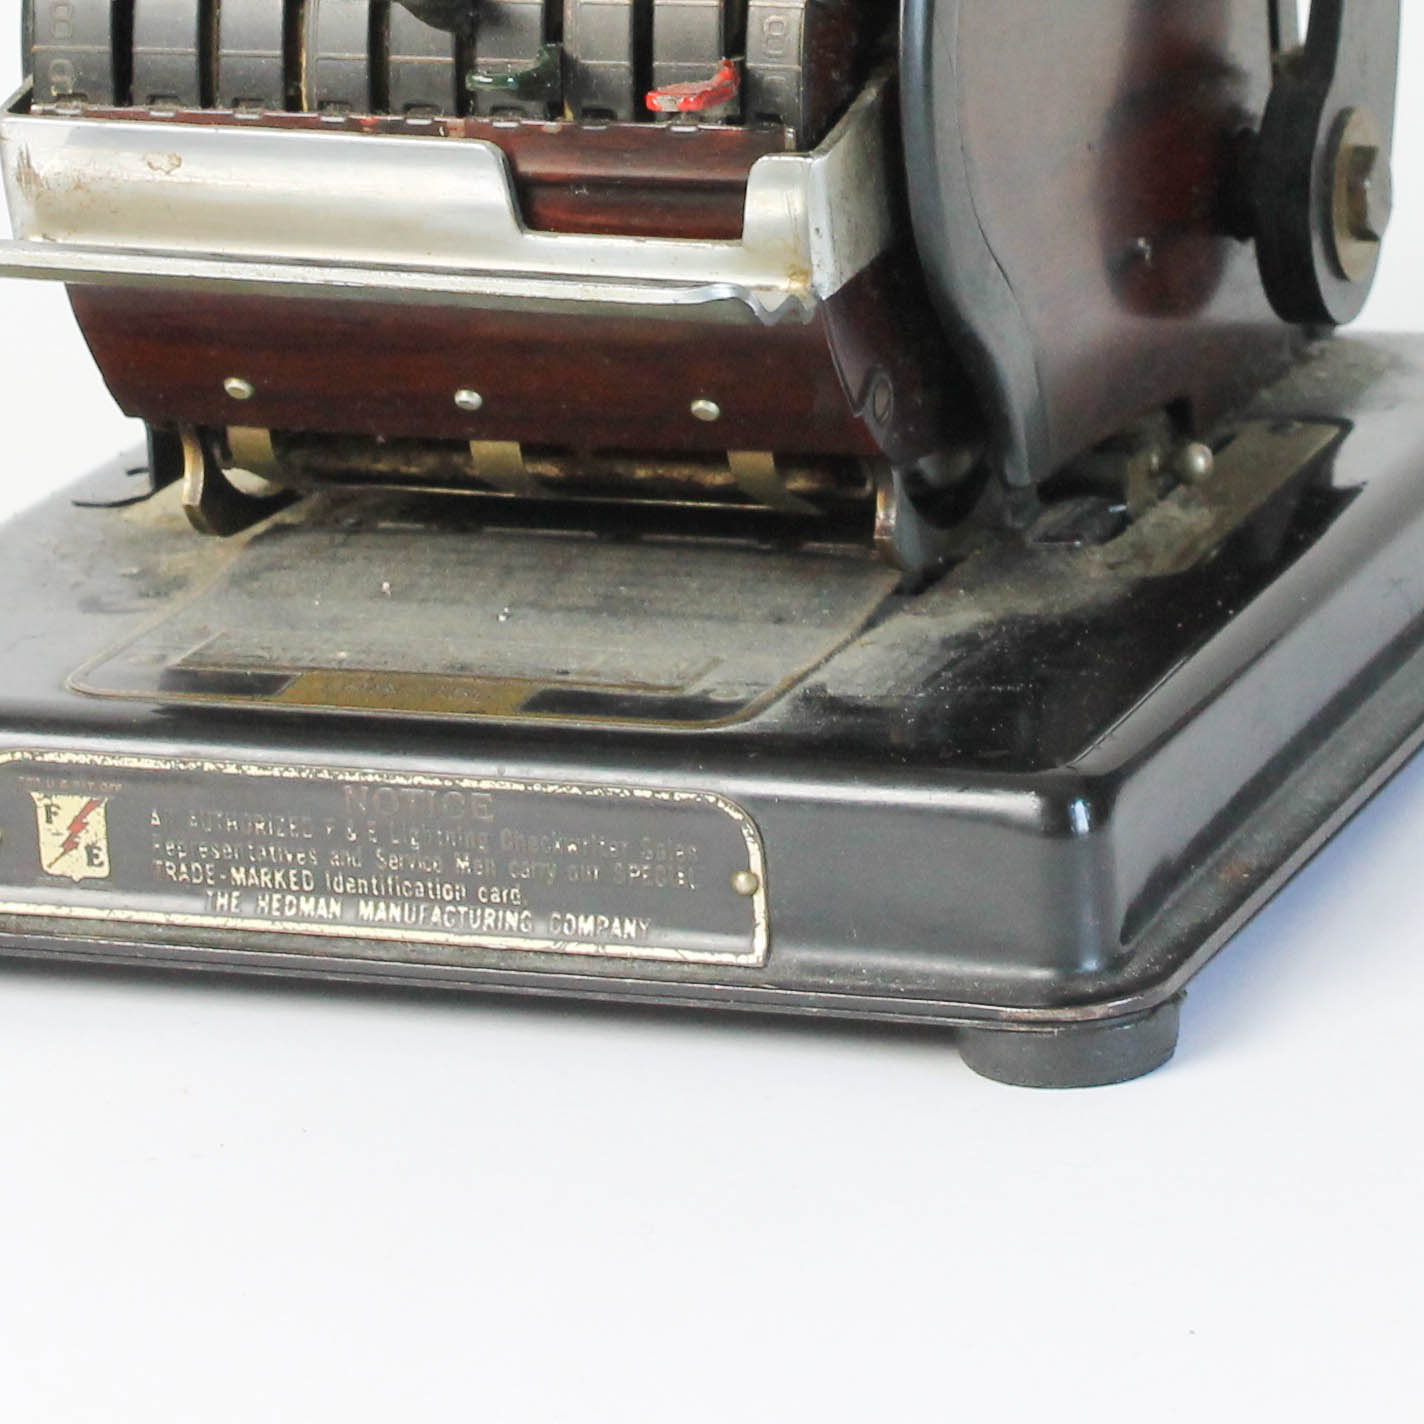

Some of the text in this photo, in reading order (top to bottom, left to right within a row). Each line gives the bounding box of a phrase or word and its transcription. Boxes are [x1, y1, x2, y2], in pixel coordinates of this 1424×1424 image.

[50, 0, 74, 41] 8
[763, 14, 788, 58] 8
[44, 802, 61, 824] F
[343, 784, 495, 822] NOTICE
[84, 841, 105, 868] E
[376, 847, 443, 875] Service
[153, 858, 315, 892] TRADE-MARKED
[326, 871, 467, 902] Identification
[205, 889, 652, 940] THE HEDMAN MANUFACTURING COMPANY
